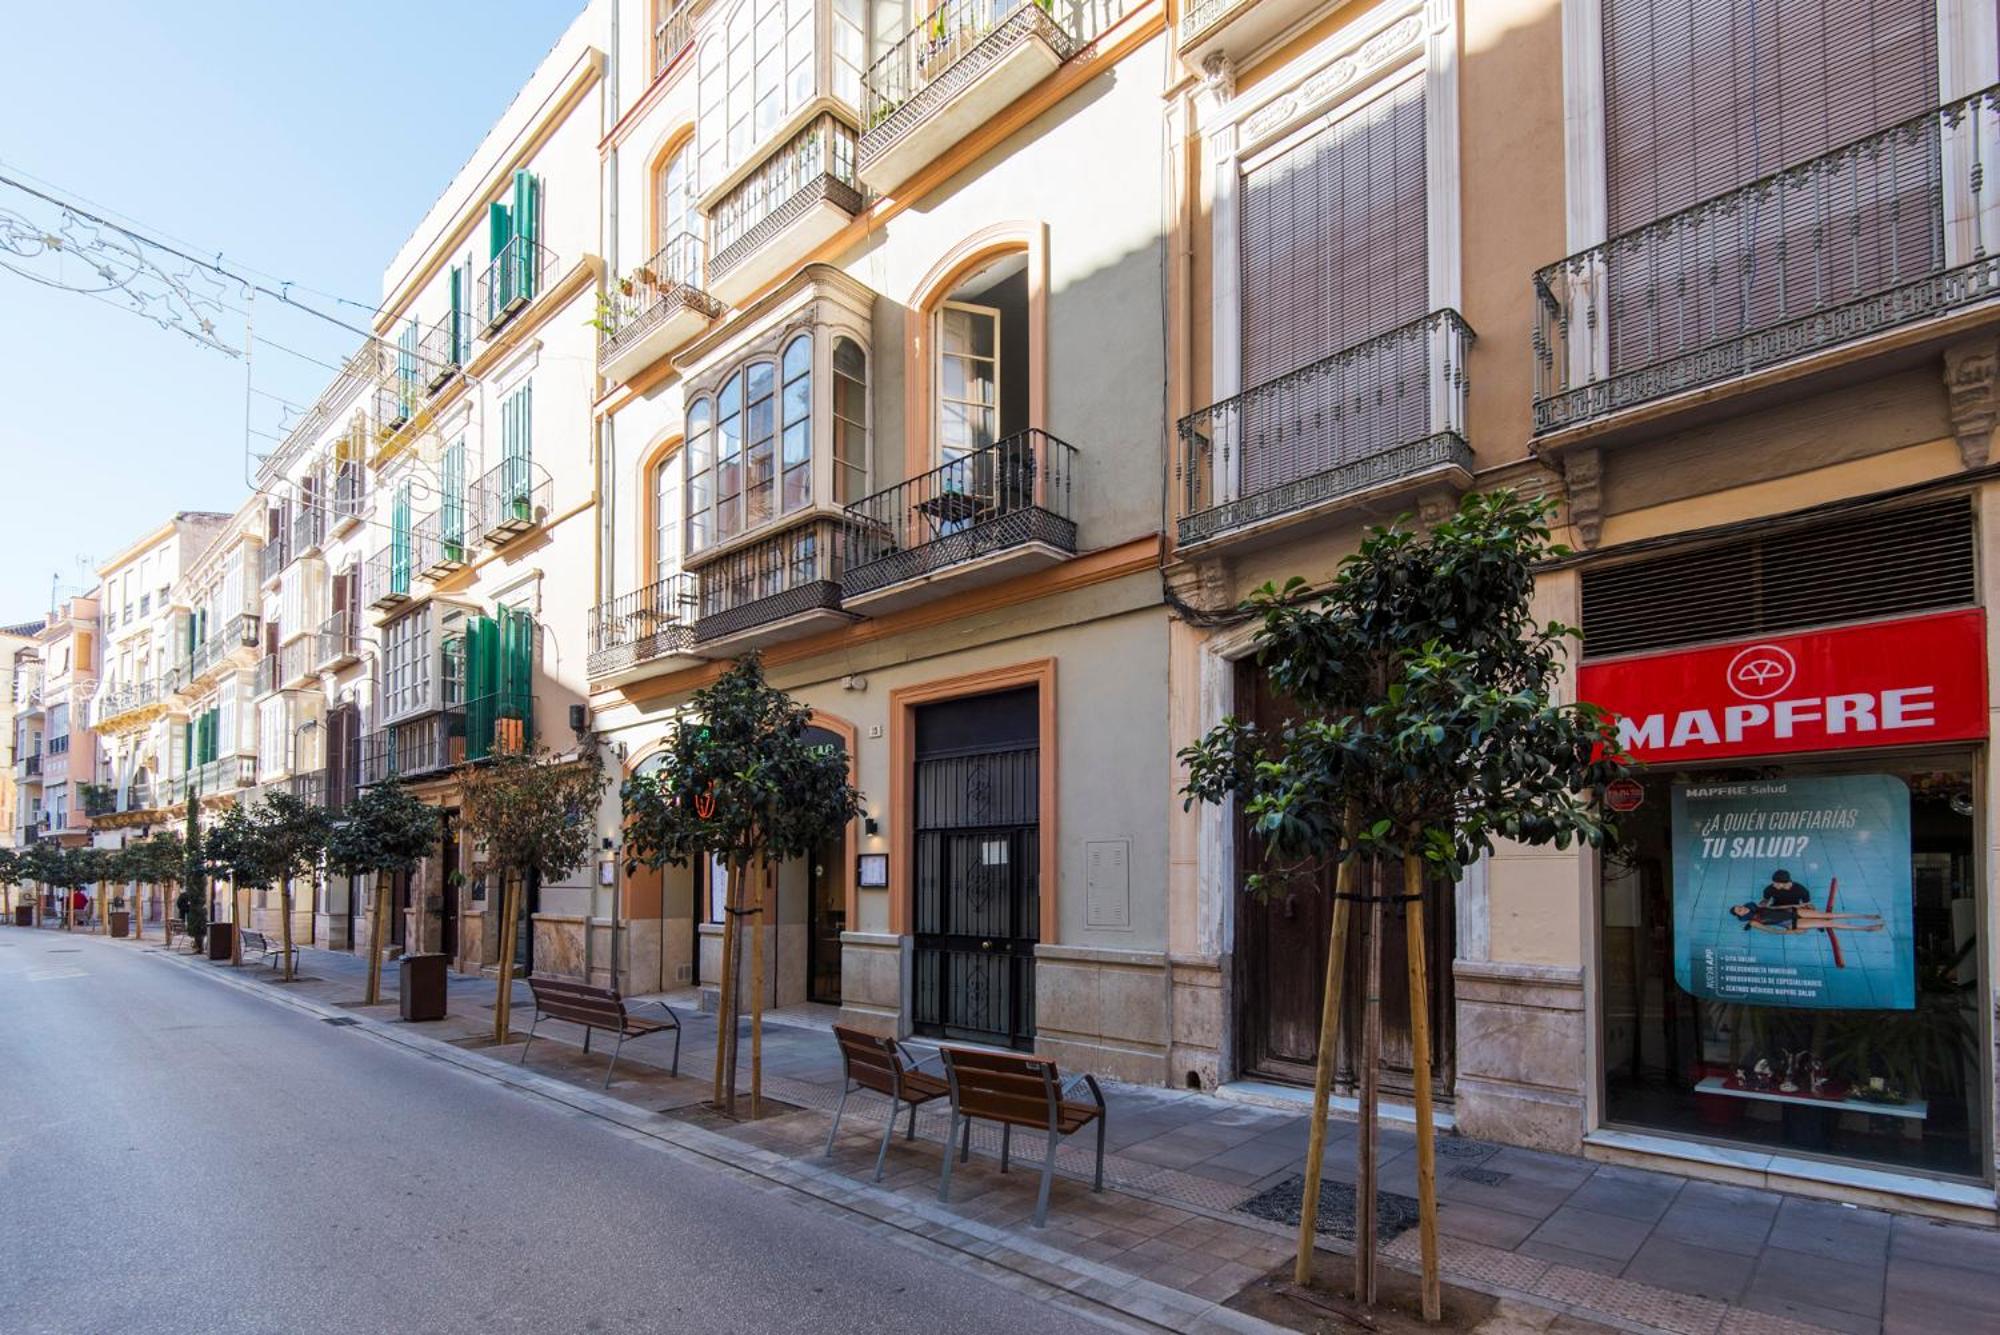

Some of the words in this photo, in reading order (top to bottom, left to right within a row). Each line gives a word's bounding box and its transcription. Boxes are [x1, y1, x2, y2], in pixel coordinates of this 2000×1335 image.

[1614, 686, 1935, 751] MAPFRE
[1686, 786, 1748, 798] MAPFRE
[1750, 783, 1788, 795] Salud
[1702, 813, 1720, 837] ¿A
[1723, 808, 1767, 834] QUIÉN
[1768, 804, 1858, 831] CONFIARÍAS
[1702, 837, 1727, 858] TU
[1730, 835, 1810, 858] SALUD?
